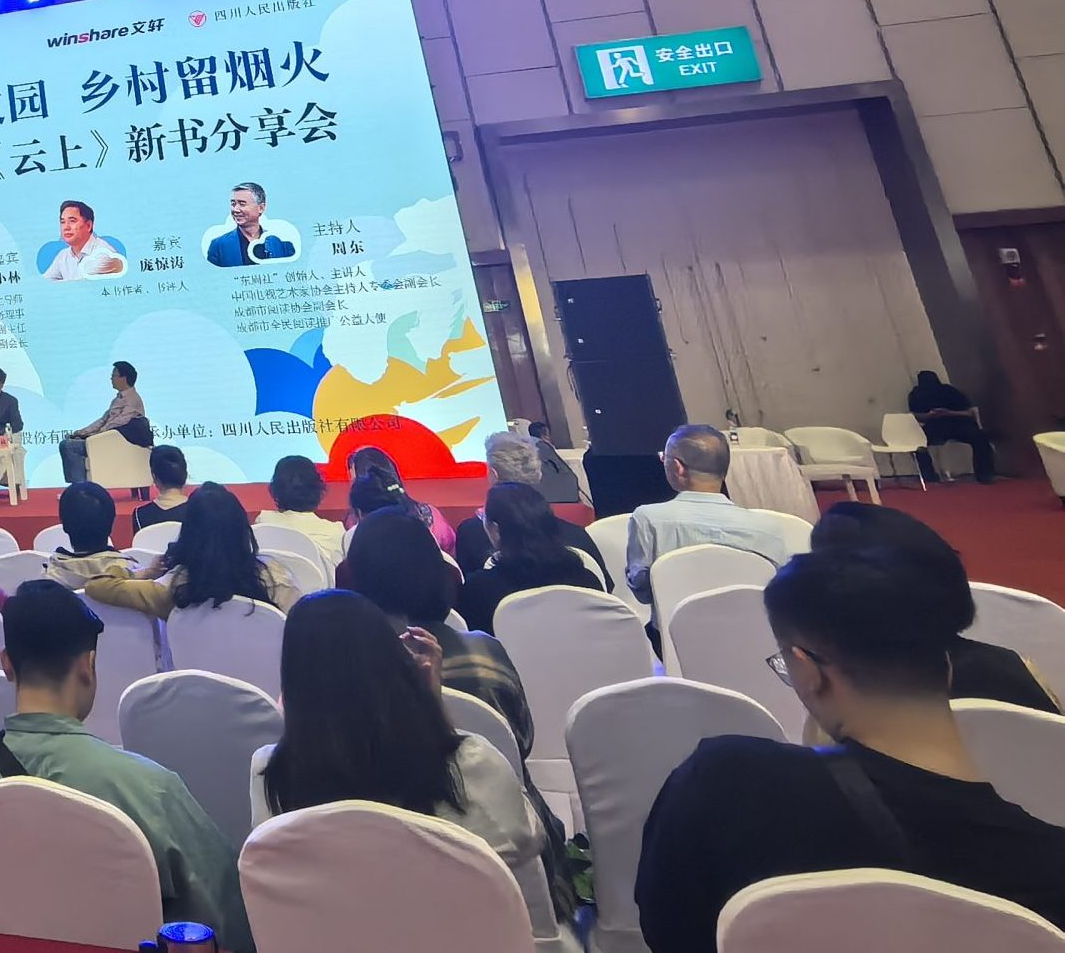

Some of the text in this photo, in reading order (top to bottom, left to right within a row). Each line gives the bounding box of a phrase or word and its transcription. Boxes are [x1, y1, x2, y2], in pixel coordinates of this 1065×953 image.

[655, 41, 733, 63] 安全出口
[80, 40, 330, 115] 乡村留烟火
[679, 62, 717, 76] EXIT
[313, 218, 361, 238] 主持人
[154, 236, 182, 251] 嘉宾
[332, 239, 365, 256] 周东
